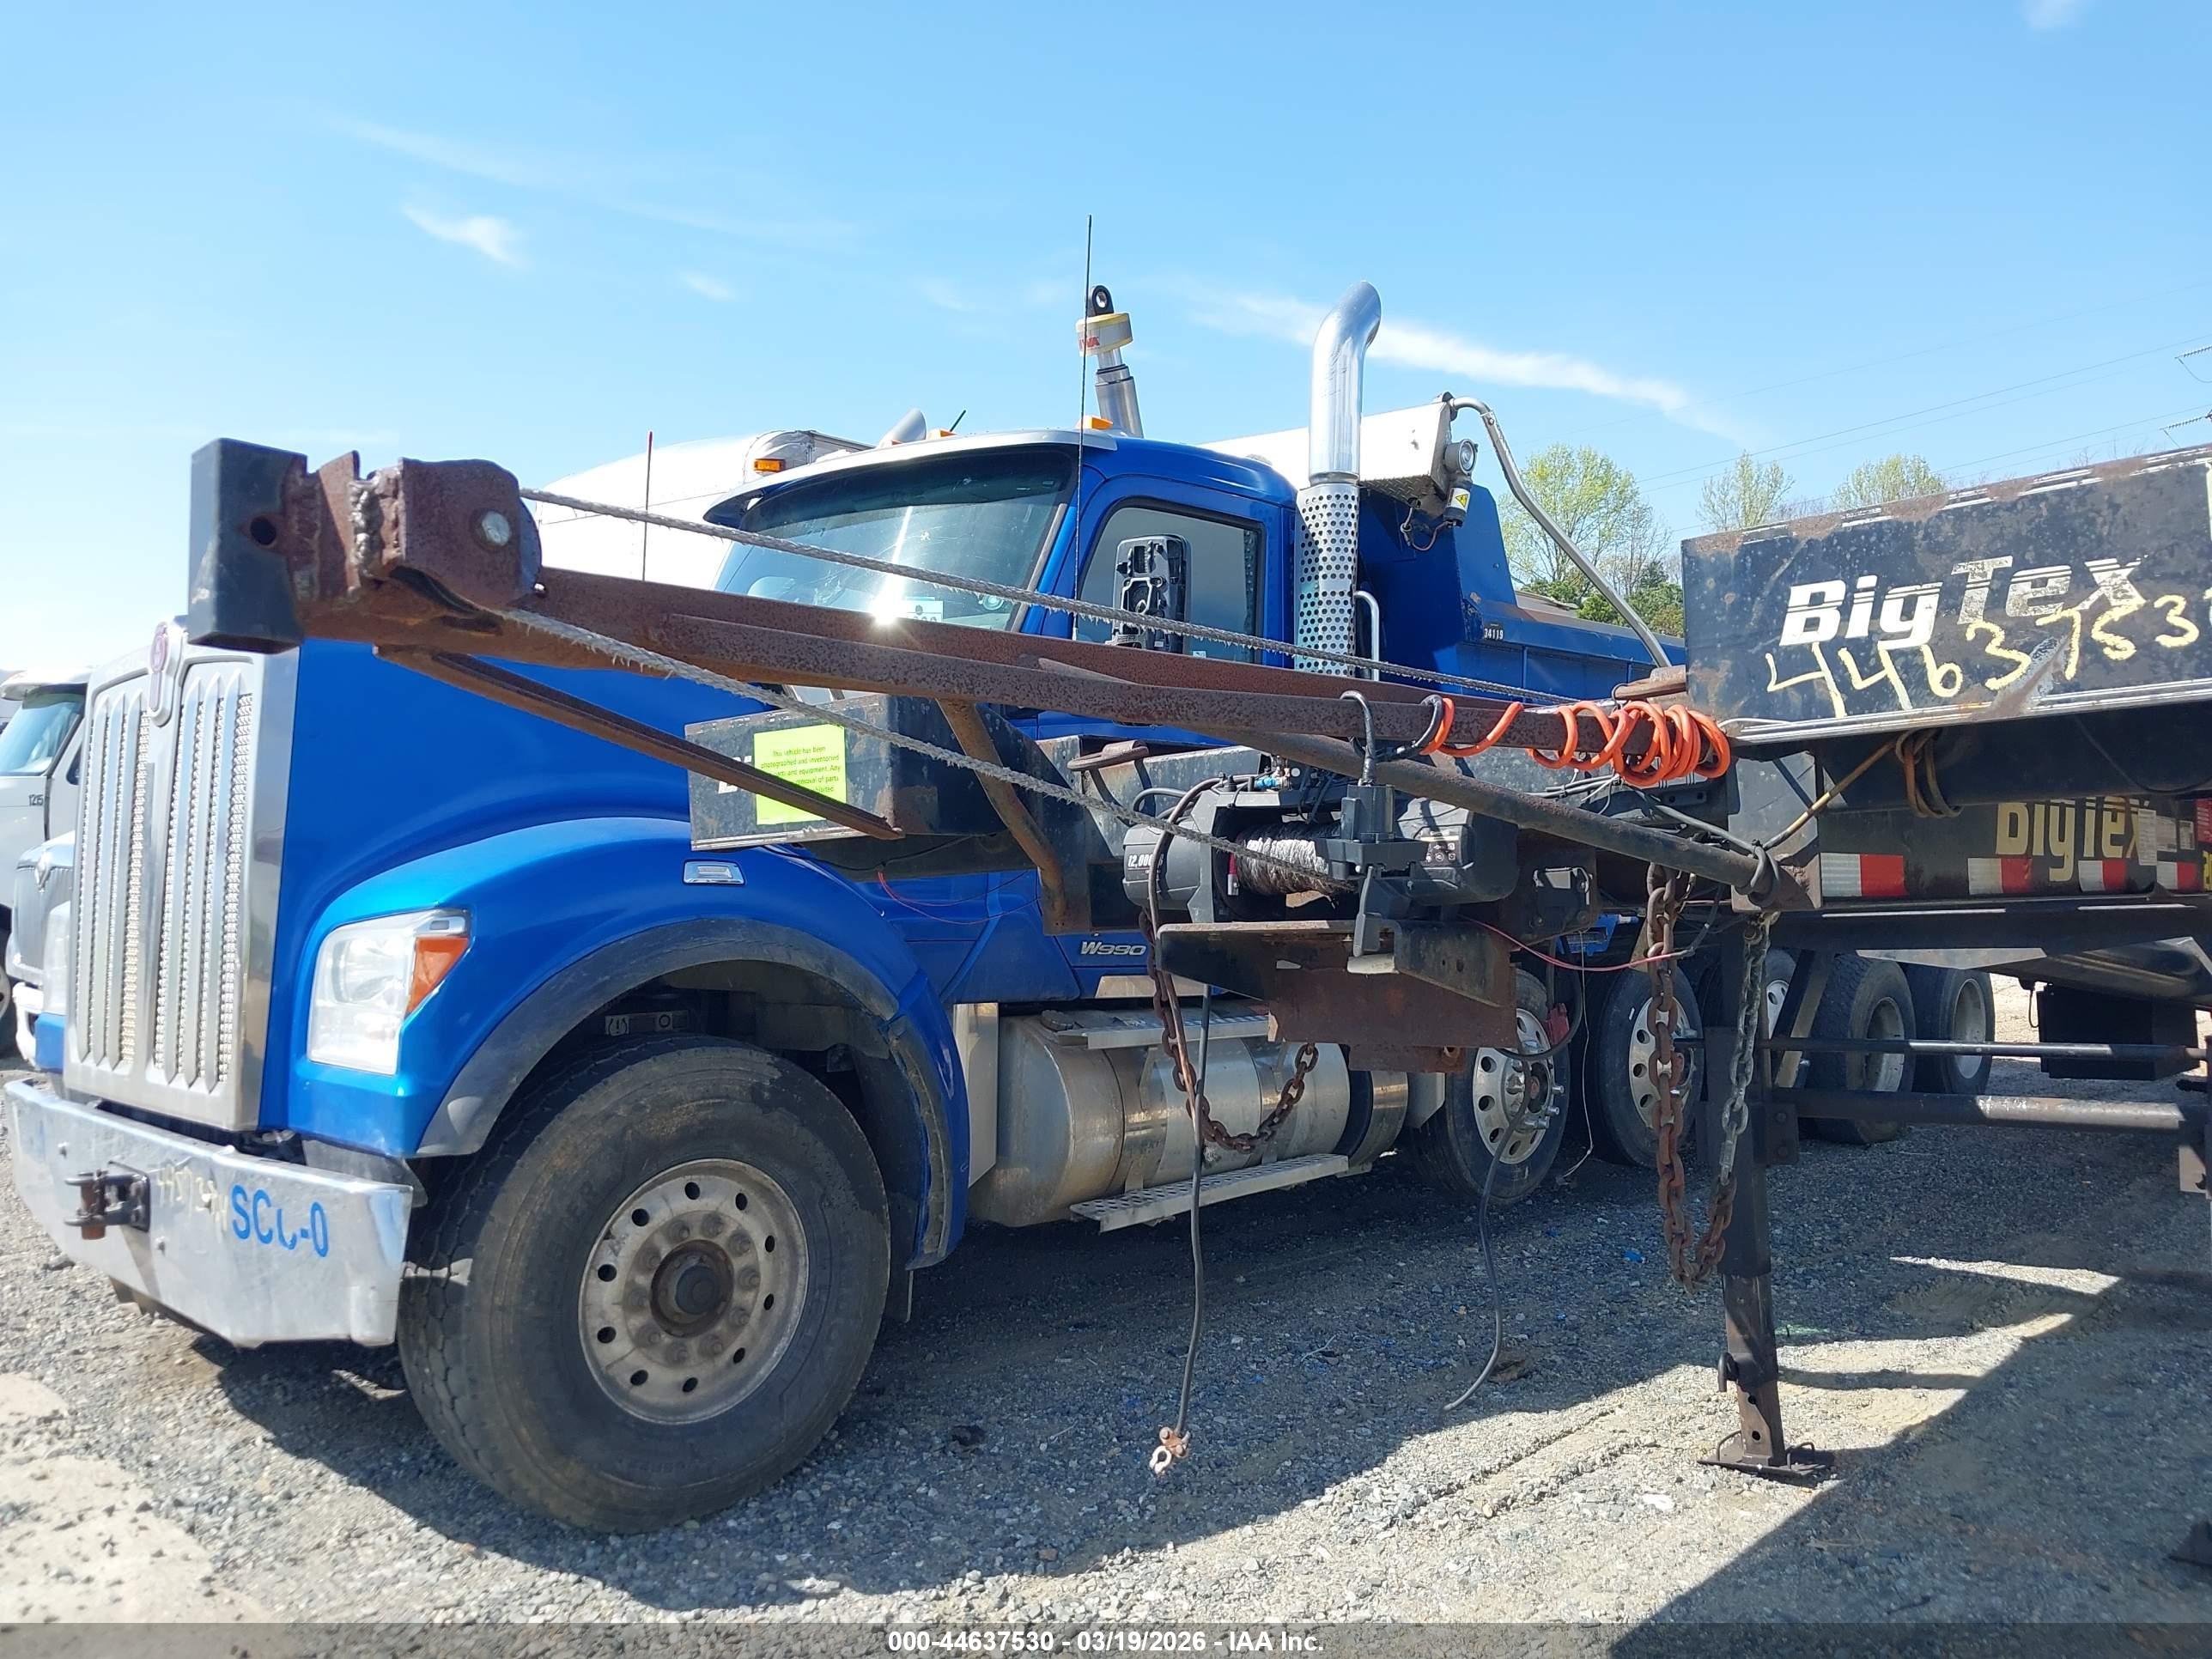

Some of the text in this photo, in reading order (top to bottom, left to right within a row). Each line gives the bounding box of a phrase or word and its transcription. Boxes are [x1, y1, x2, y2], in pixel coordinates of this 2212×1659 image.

[1484, 628, 1504, 641] 34119
[1765, 587, 2212, 718] 4463753
[784, 747, 802, 756] vehicle
[761, 759, 797, 769] photographed
[809, 755, 840, 763] inventoried
[825, 775, 839, 784] parts
[1080, 941, 1147, 956] W990
